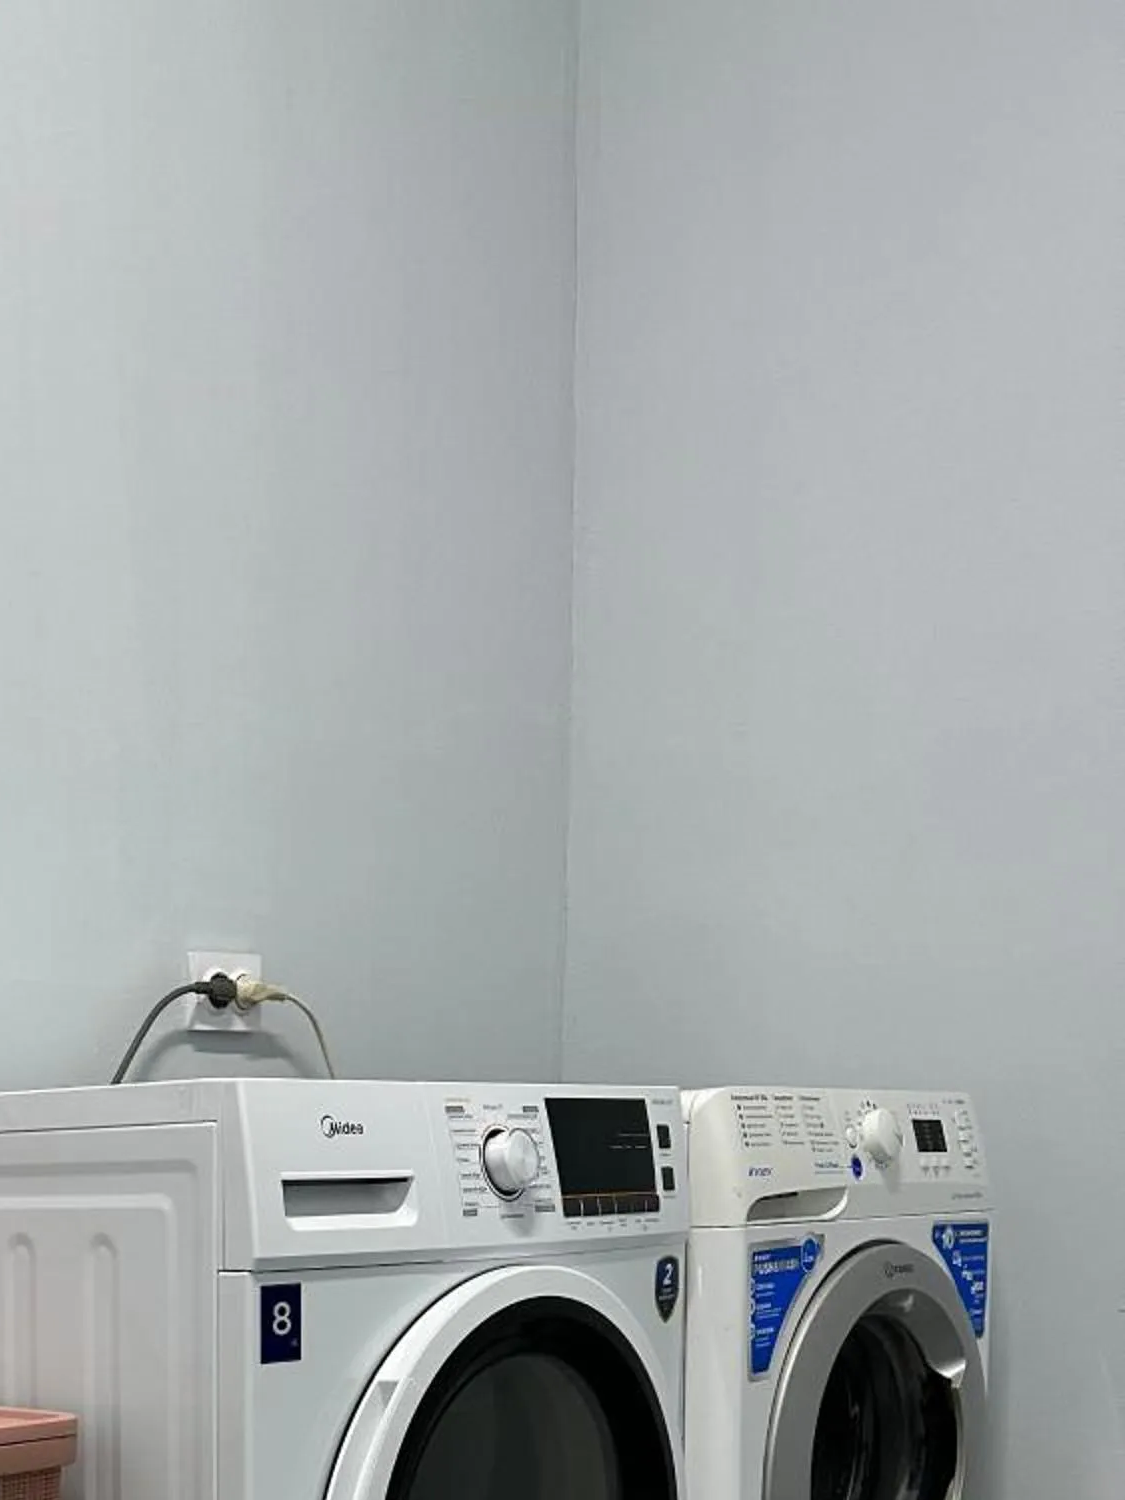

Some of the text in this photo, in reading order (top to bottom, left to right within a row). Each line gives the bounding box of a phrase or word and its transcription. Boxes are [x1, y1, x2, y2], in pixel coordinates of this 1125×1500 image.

[321, 1114, 364, 1138] Midea
[663, 1263, 673, 1285] 2
[273, 1301, 292, 1336] 8
